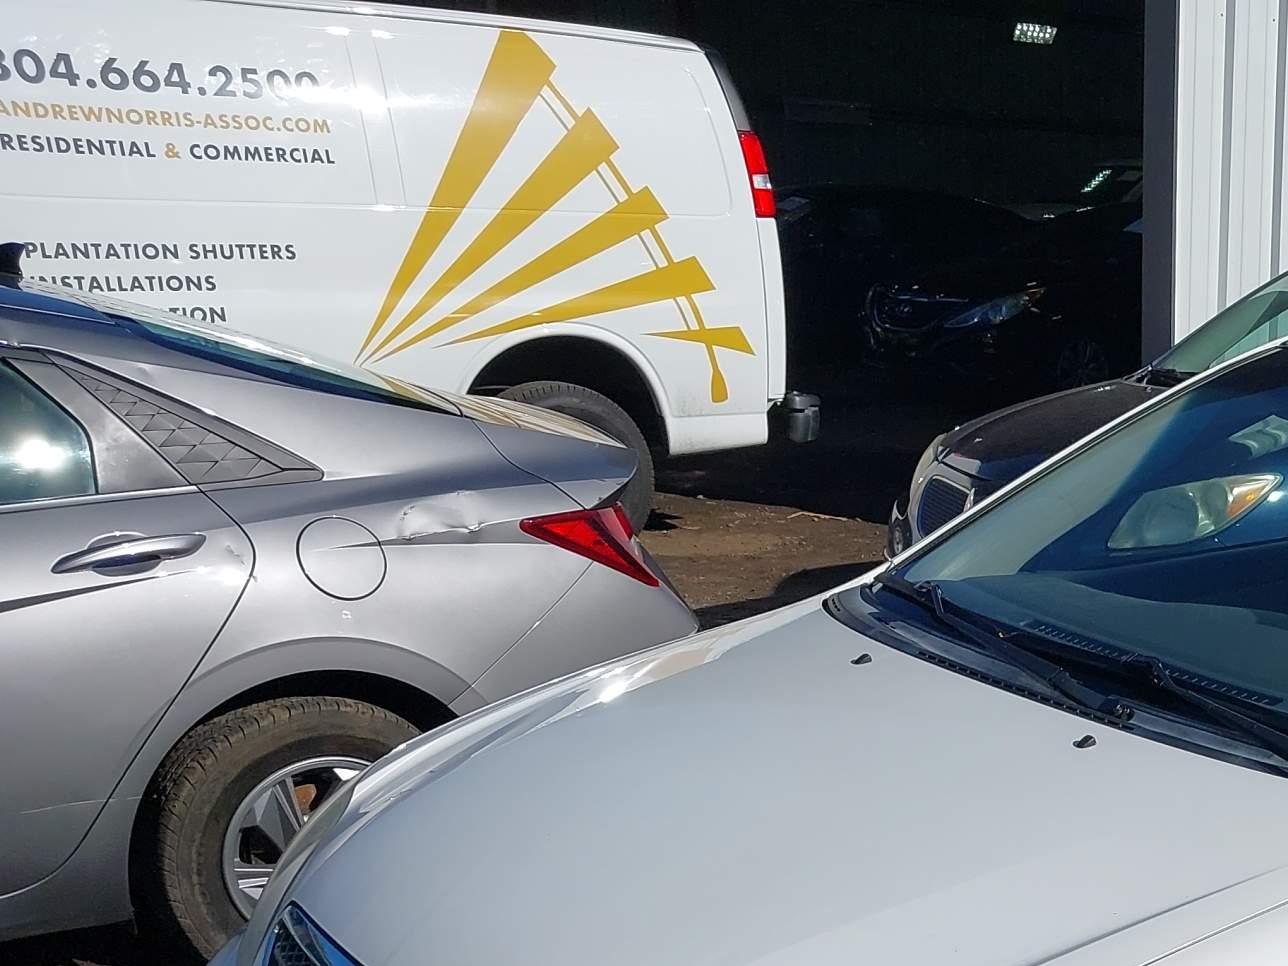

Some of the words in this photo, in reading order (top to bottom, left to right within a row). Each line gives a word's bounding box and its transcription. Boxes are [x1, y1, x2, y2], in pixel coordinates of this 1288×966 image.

[0, 133, 157, 159] RESIDENTIAL
[164, 142, 181, 160] &
[189, 143, 336, 164] COMMERCIAL
[25, 241, 180, 261] PLANTATION
[189, 243, 297, 261] SHUTTERS
[29, 275, 217, 292] STALLATIONS
